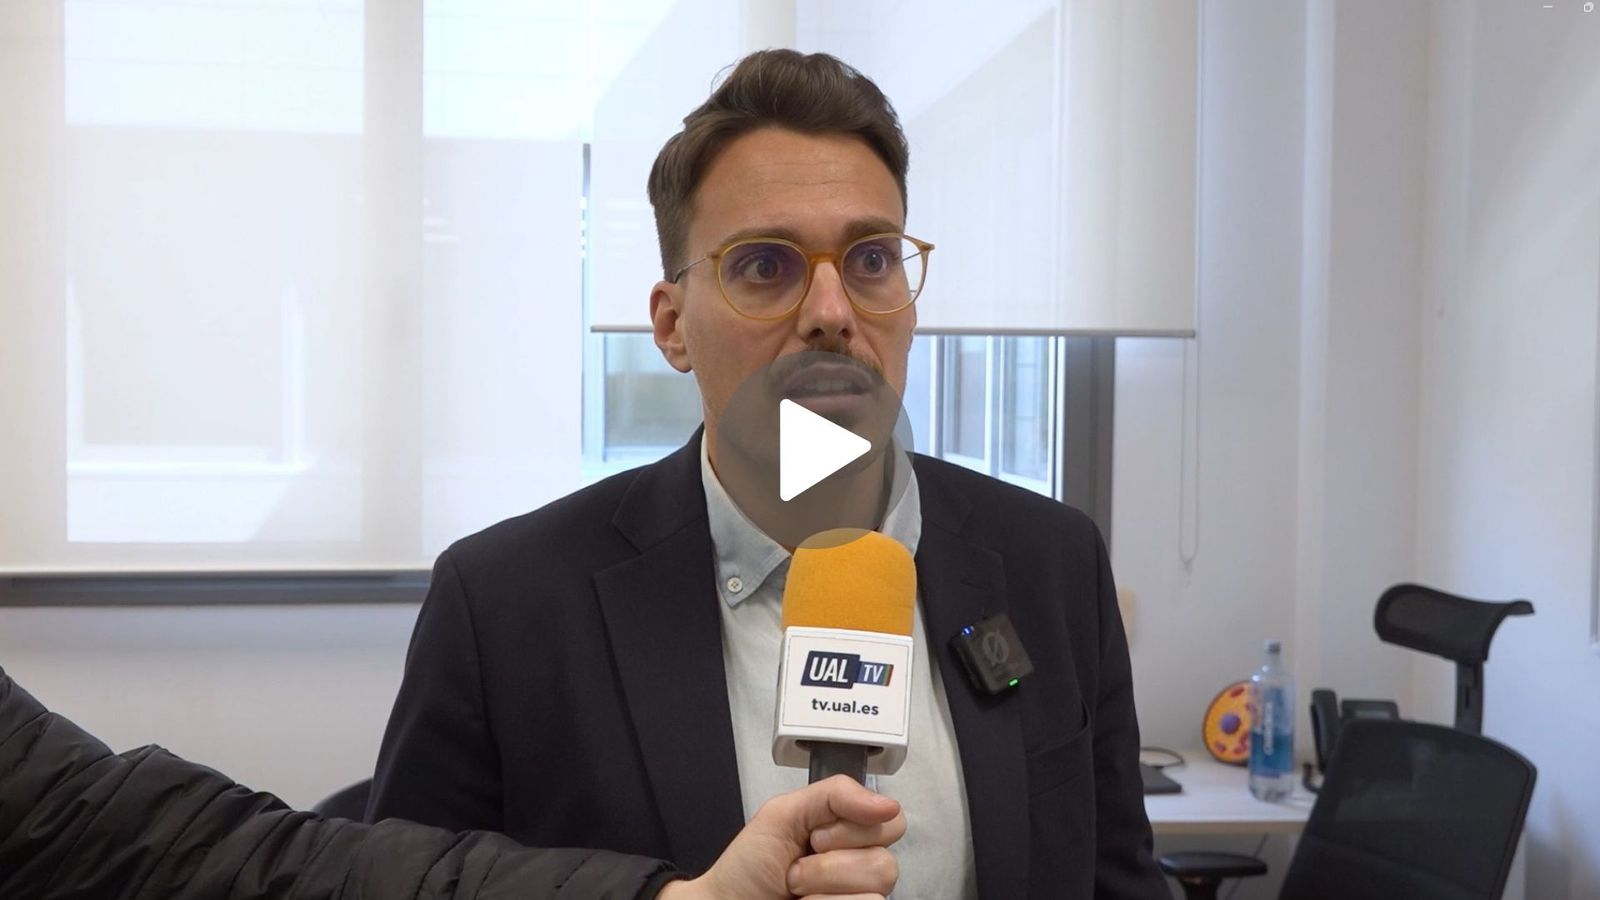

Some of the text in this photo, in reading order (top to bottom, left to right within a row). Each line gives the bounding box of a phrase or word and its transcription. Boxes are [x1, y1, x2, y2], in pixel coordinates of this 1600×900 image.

[809, 657, 884, 683] UAL TV
[811, 698, 879, 715] tv.ual.es
